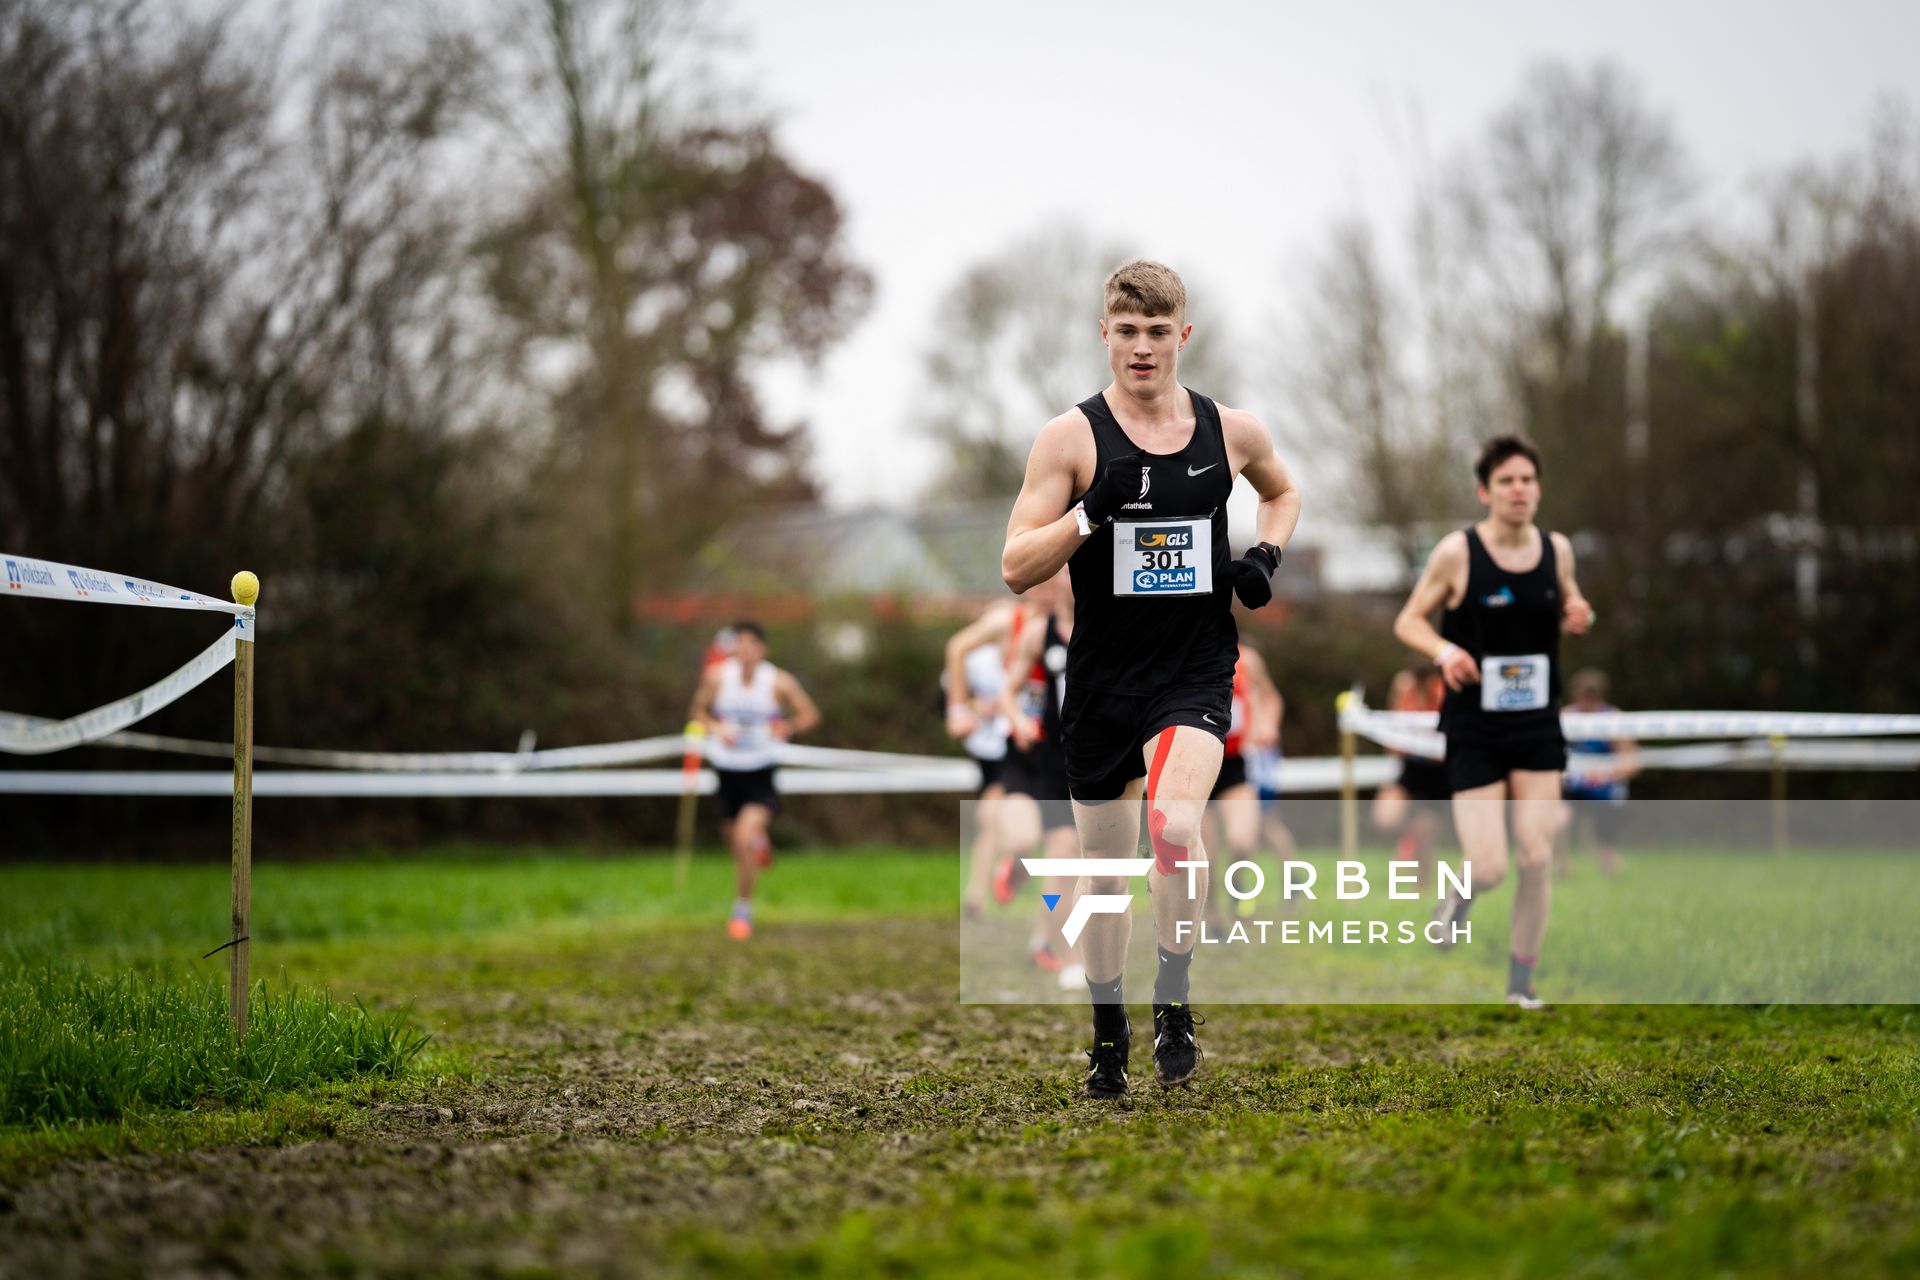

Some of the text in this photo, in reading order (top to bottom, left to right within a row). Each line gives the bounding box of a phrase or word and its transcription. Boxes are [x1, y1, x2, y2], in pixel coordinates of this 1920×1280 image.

[1166, 533, 1189, 546] GLS
[1141, 551, 1186, 570] 301
[1160, 572, 1193, 583] PLAN
